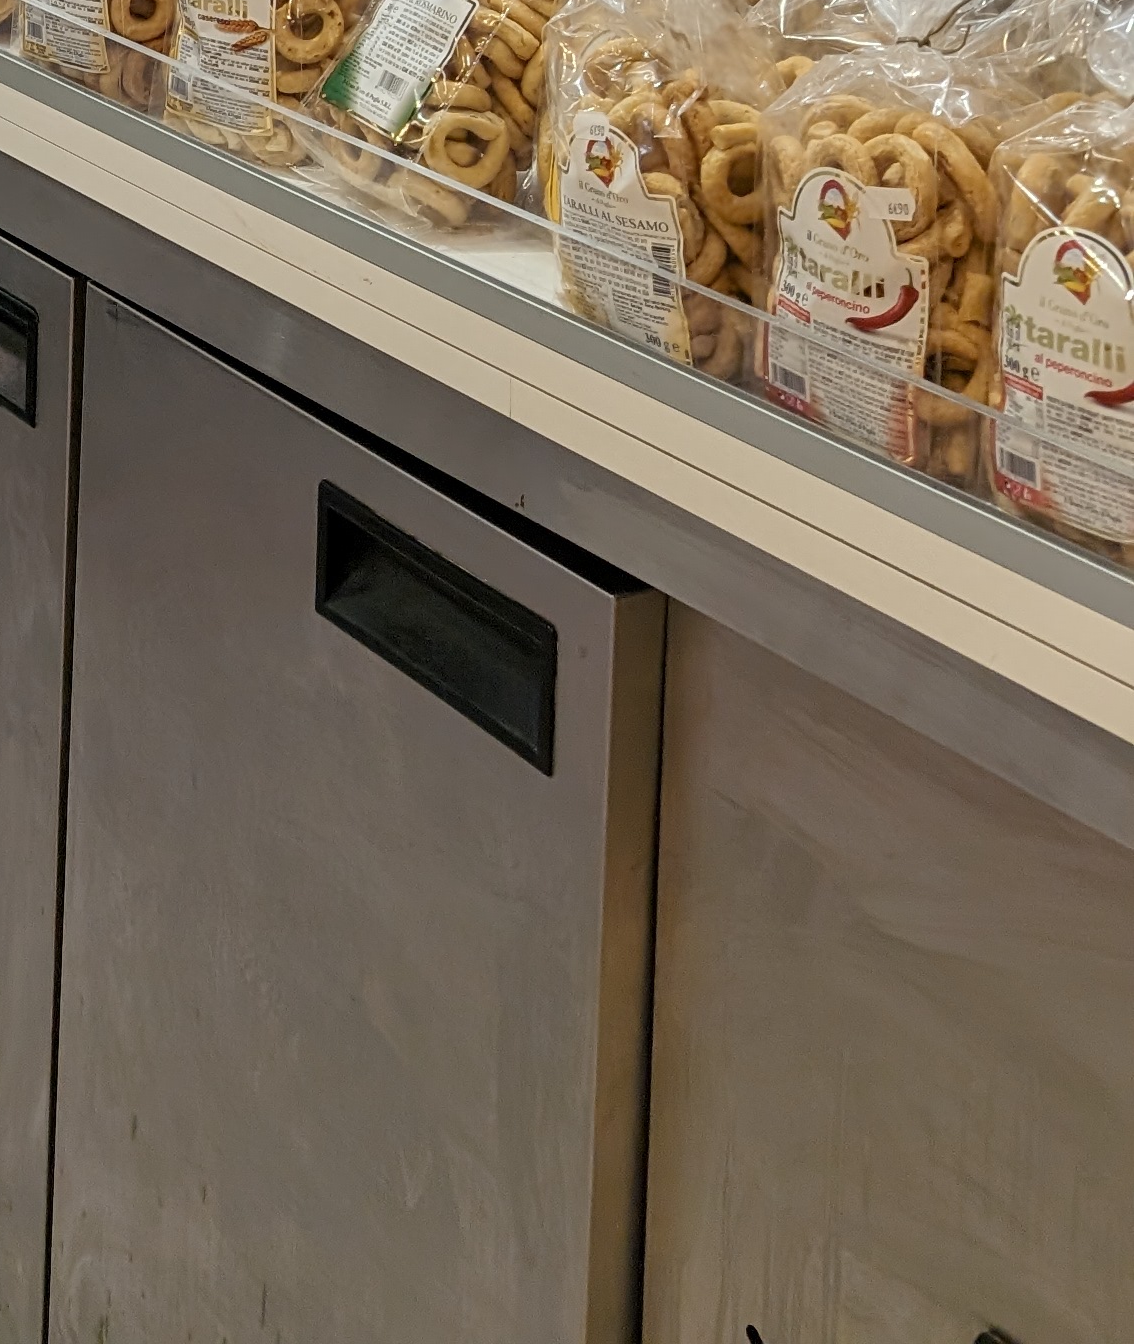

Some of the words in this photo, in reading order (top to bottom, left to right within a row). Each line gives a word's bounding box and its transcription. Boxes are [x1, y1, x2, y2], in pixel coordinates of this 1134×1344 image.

[615, 213, 669, 233] SESAMO
[799, 247, 885, 299] taralli
[811, 286, 870, 315] peperoncino
[1024, 315, 1126, 373] taralli
[1045, 358, 1113, 388] peperoncino
